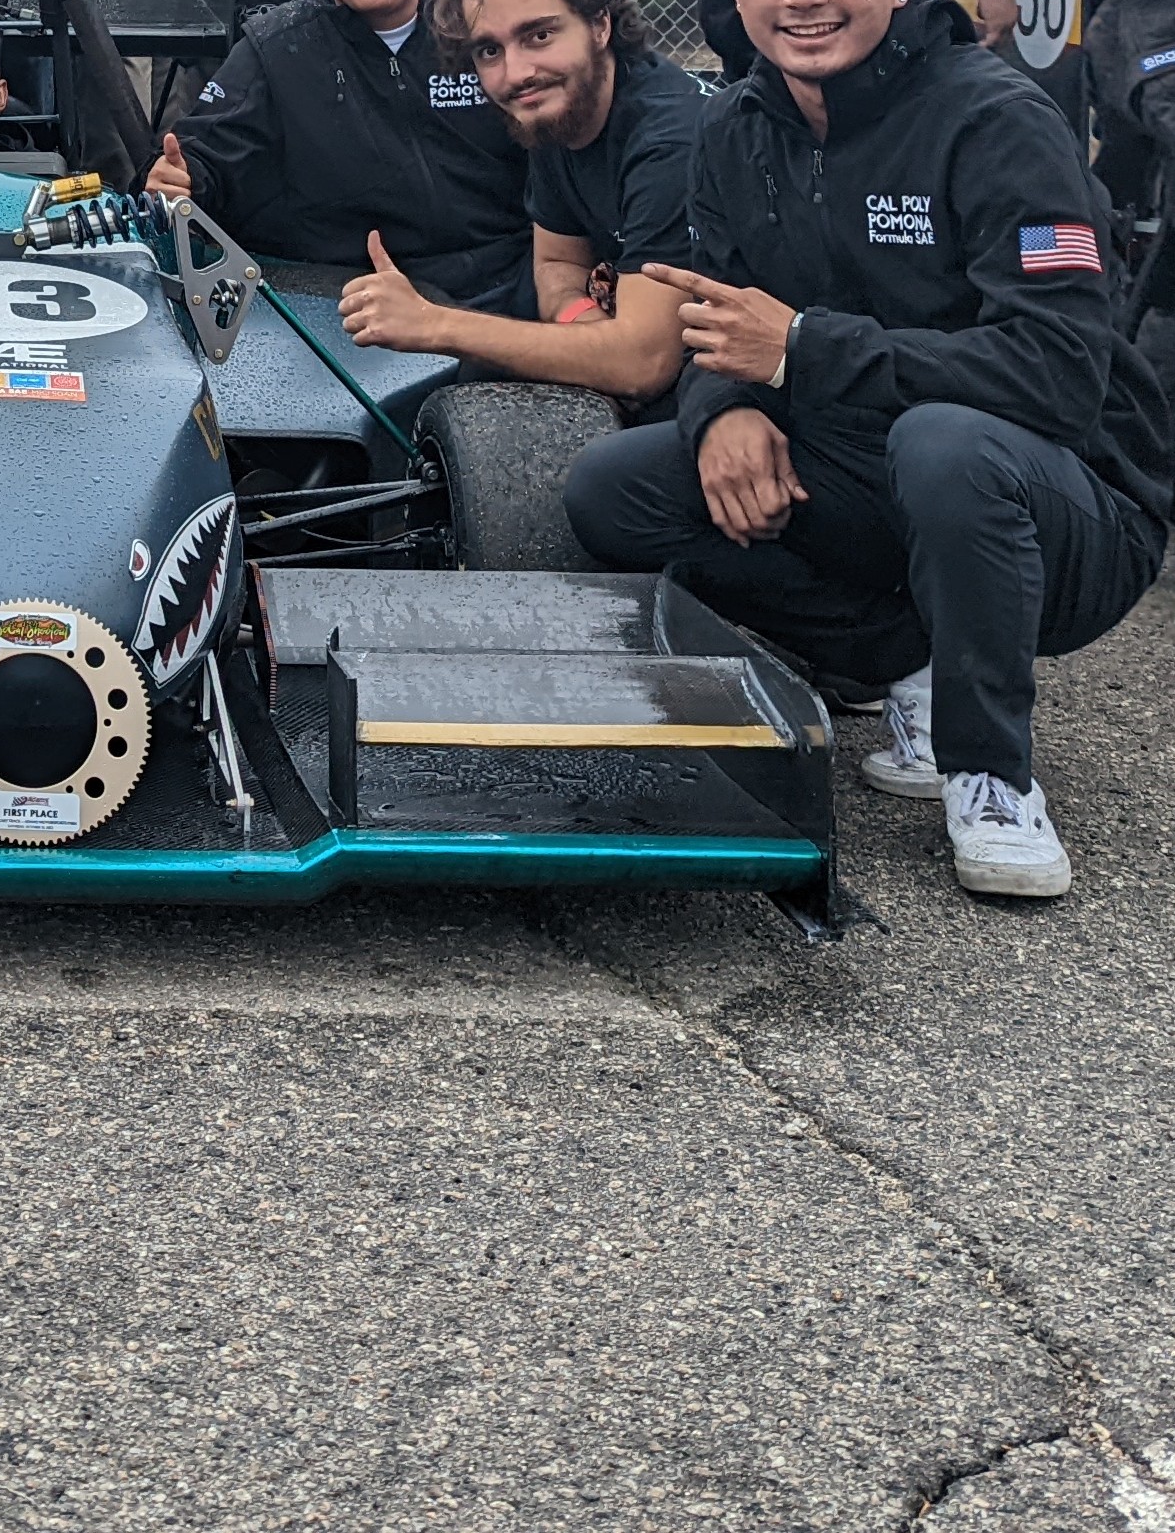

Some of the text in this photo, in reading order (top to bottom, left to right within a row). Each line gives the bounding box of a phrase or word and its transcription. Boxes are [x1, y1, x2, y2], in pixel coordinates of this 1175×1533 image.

[428, 74, 456, 87] CAL
[429, 85, 484, 98] POMON
[430, 95, 489, 108] Formula SA
[866, 194, 931, 213] CAL POLY
[867, 212, 934, 232] POMONA
[868, 229, 936, 245] Formula SAE
[3, 808, 59, 819] FIRST PLACE
